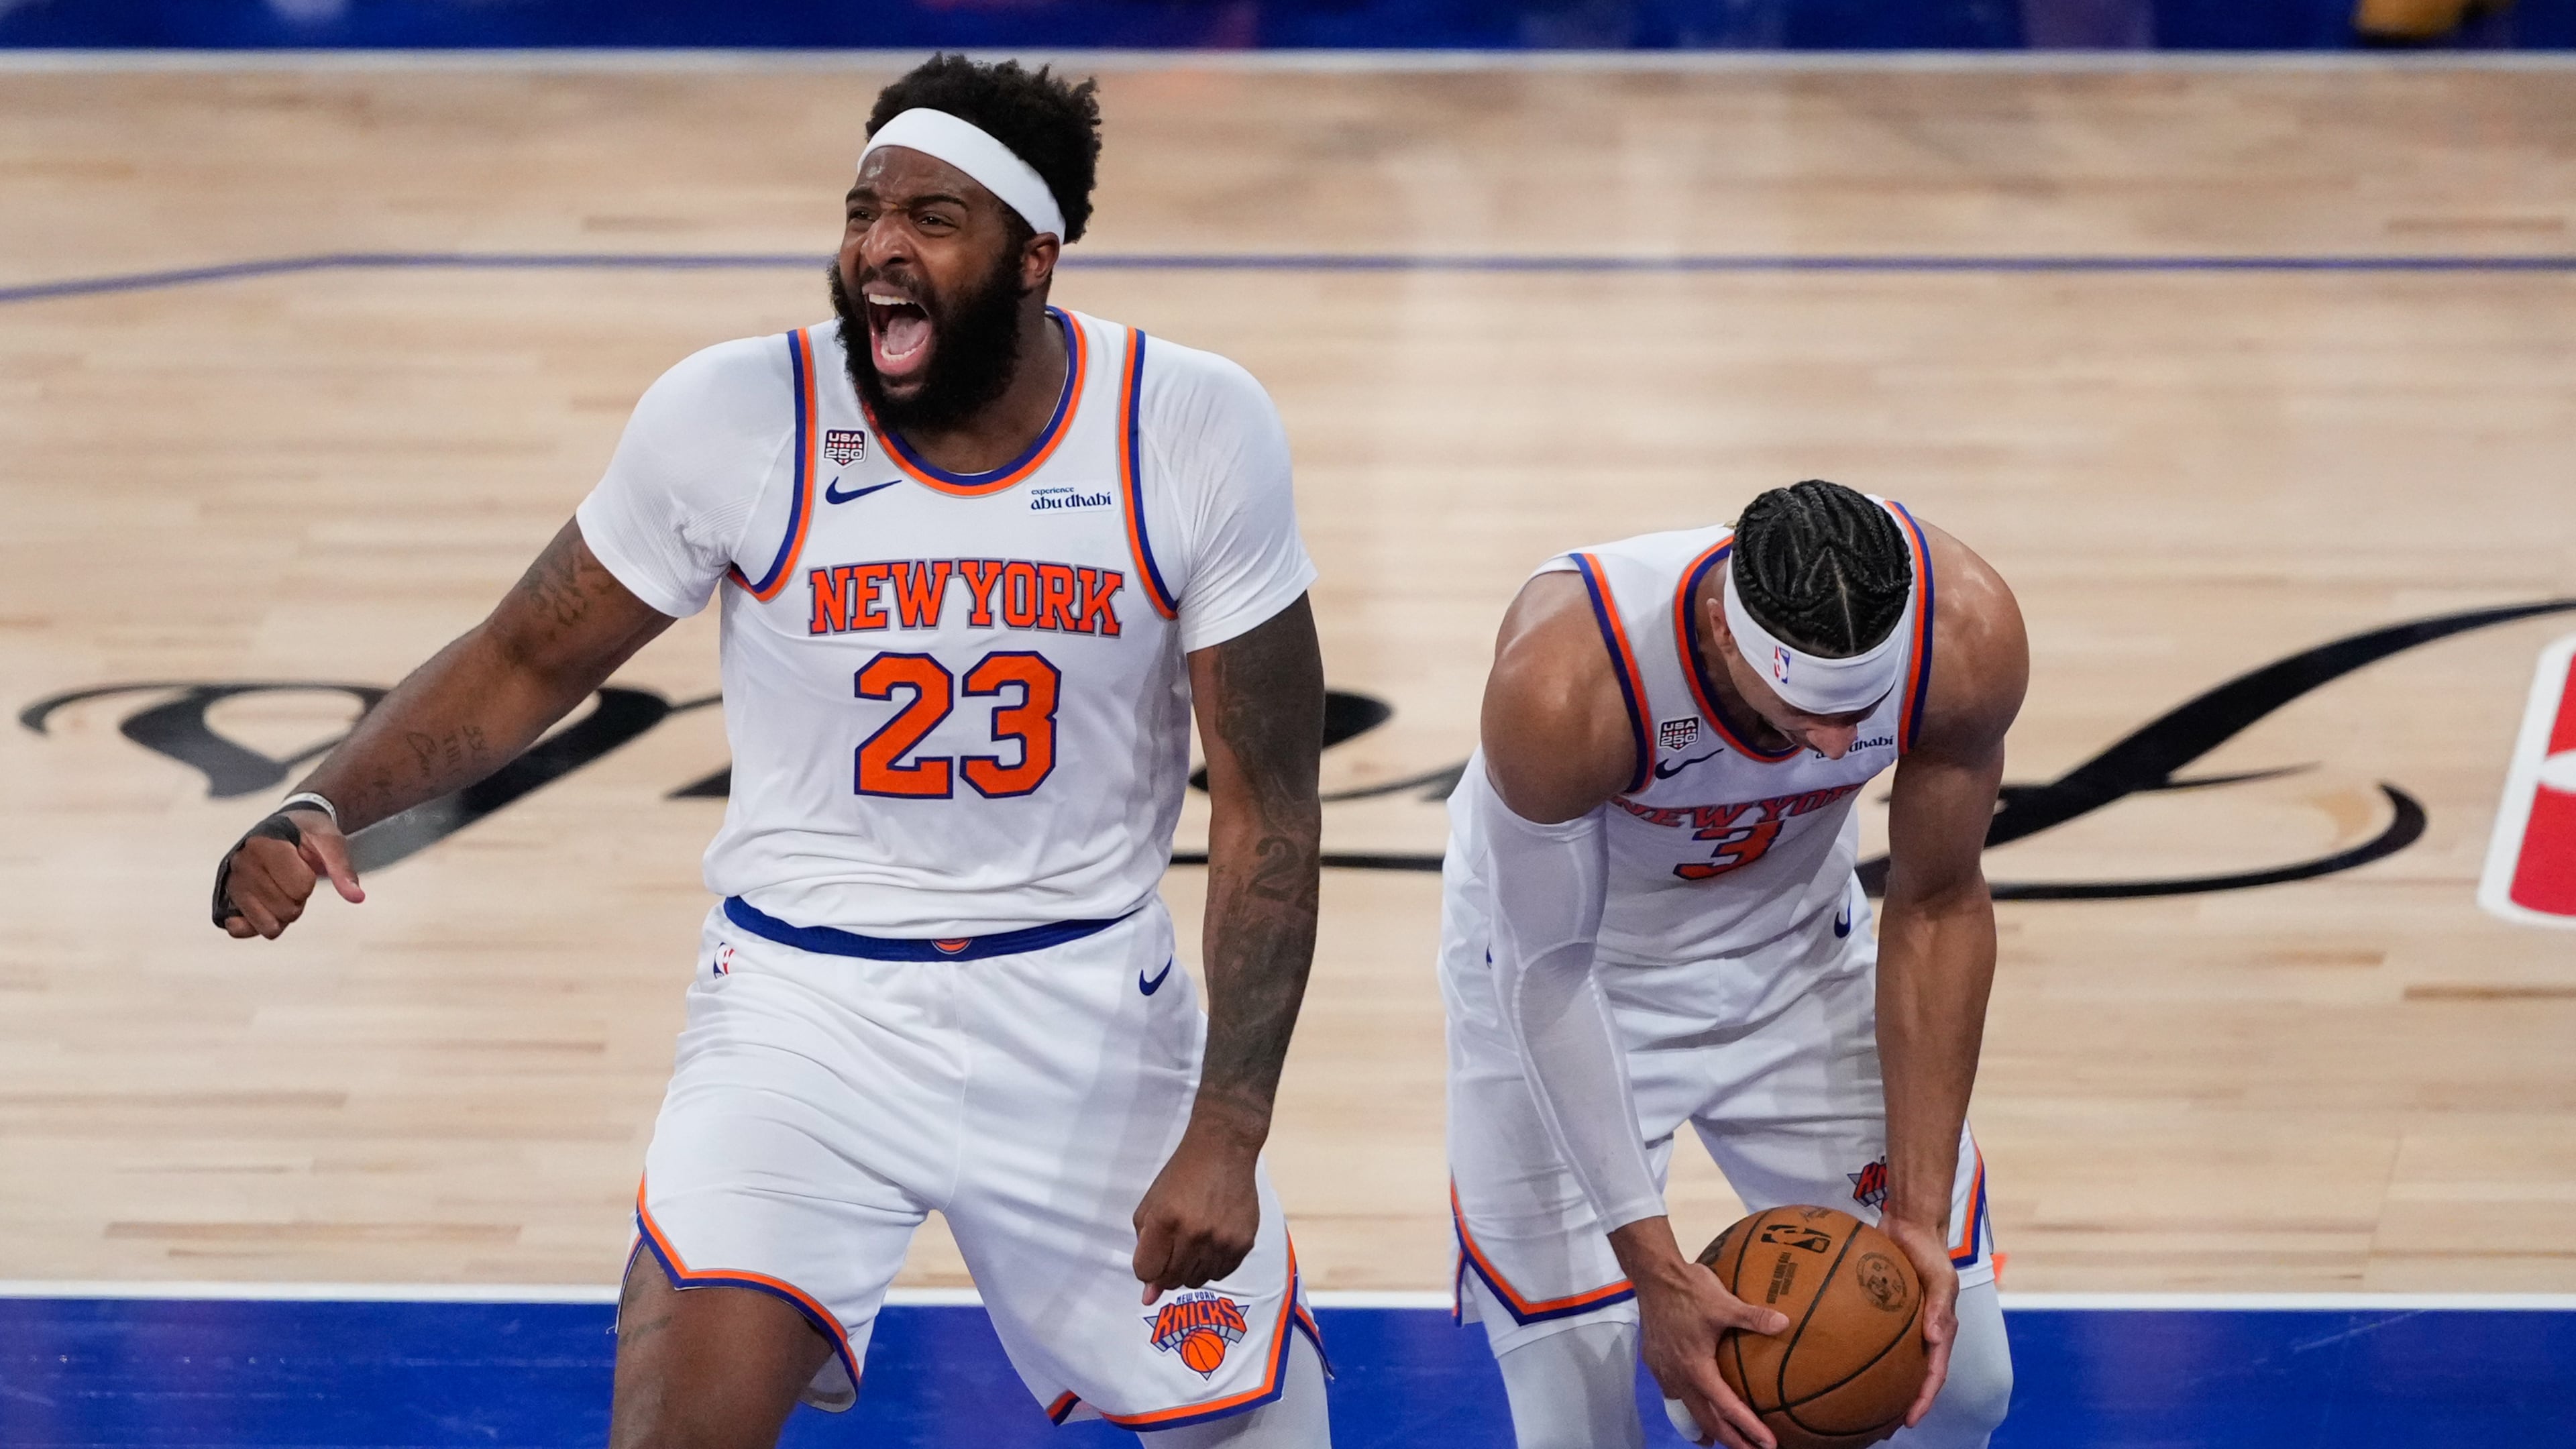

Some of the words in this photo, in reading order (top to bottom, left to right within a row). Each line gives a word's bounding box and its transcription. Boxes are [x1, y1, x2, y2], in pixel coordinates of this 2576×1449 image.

[828, 433, 863, 443] USA
[825, 448, 863, 460] 250
[1031, 487, 1075, 496] experience
[1031, 496, 1062, 510] abu
[1065, 492, 1112, 508] dhabi
[810, 558, 951, 636] NEW
[957, 558, 1125, 638] YORK
[854, 651, 1061, 799] 23
[1664, 720, 1696, 731] USA
[1660, 733, 1697, 746] 250
[1611, 795, 1754, 829] NEW
[1673, 820, 1785, 880] 3
[1176, 1291, 1193, 1304] NEW
[1195, 1291, 1216, 1300] YORK
[1150, 1297, 1248, 1344] KNICKS
